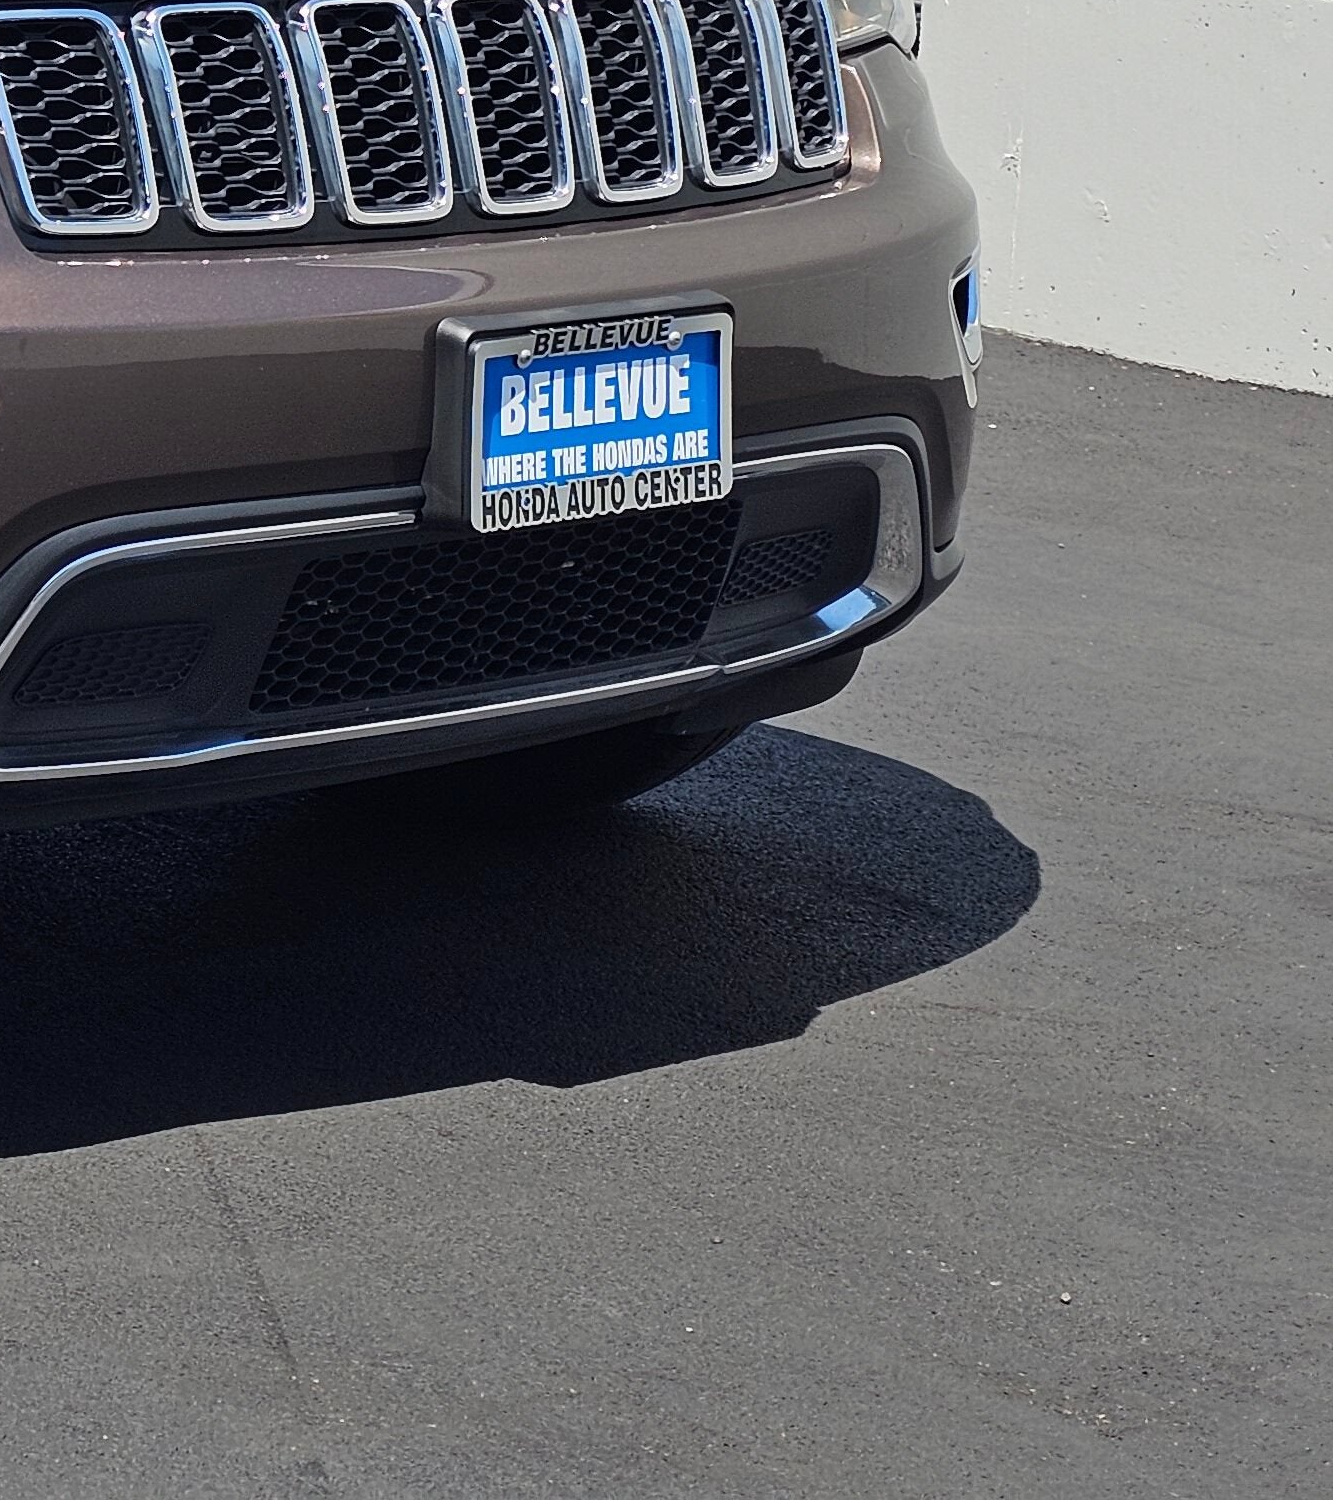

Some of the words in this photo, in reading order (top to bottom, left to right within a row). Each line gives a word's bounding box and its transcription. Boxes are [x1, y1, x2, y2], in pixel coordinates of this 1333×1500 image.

[533, 317, 673, 356] BELLEVUE
[500, 354, 691, 437] BELLEVUE
[482, 451, 547, 486] WHERE
[552, 446, 586, 477] THE
[592, 434, 667, 473] HONDAS
[673, 429, 709, 459] ARE
[482, 486, 561, 529] HONDA
[567, 477, 626, 518] AUTO
[634, 462, 722, 509] CENTER
